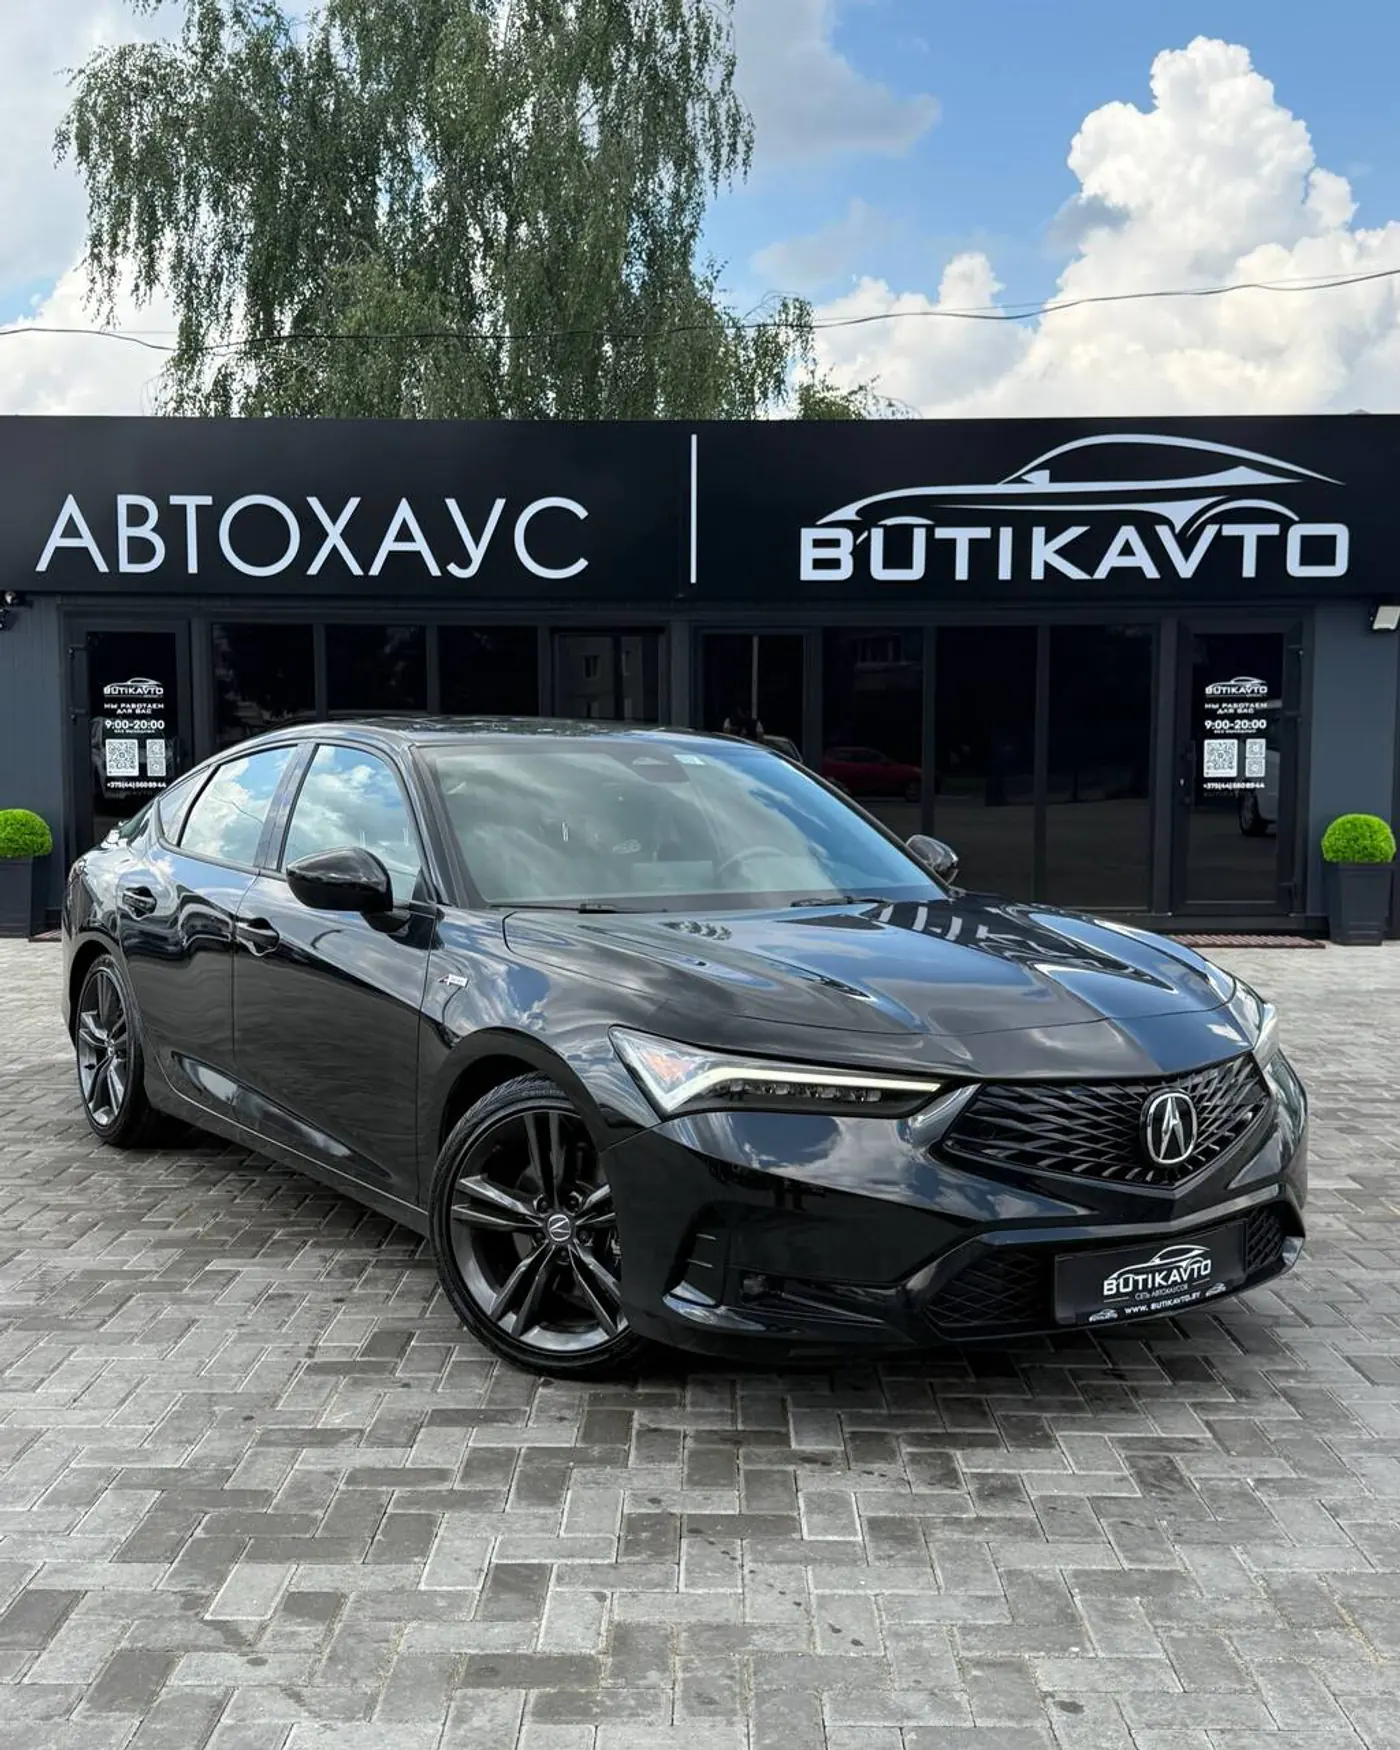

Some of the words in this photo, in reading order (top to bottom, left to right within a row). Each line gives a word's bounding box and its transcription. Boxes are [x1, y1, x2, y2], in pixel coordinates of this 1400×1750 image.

[35, 493, 590, 580] АВТОХАУС
[799, 522, 1350, 581] BUTIKAVTO
[105, 719, 165, 730] 9:00-20:00
[1204, 719, 1267, 730] 9:00-20:00
[1103, 1259, 1212, 1296] BUTIKAVTO
